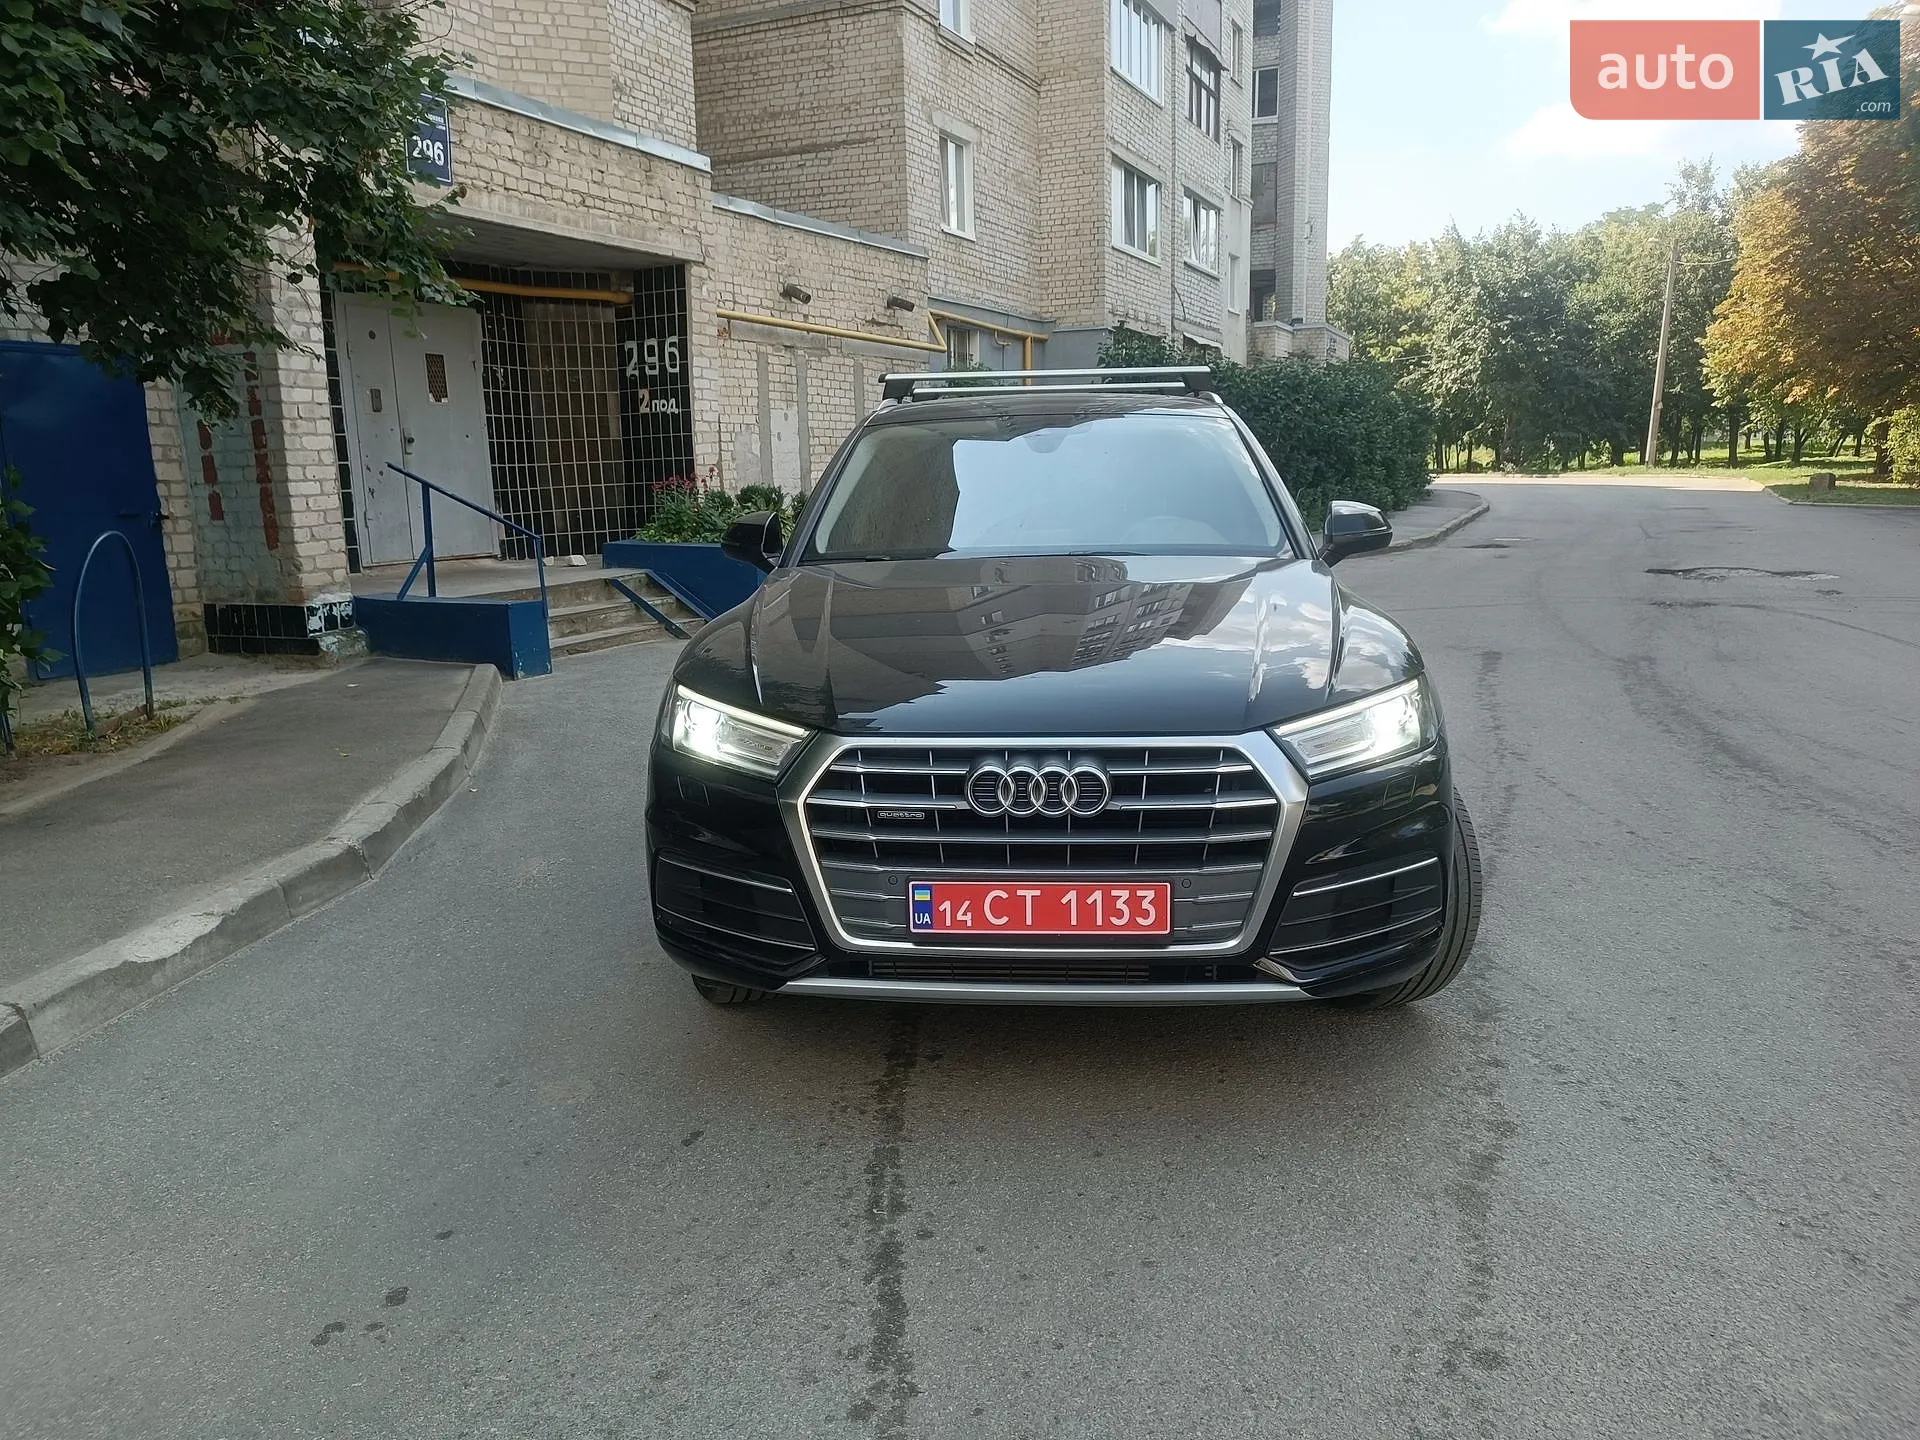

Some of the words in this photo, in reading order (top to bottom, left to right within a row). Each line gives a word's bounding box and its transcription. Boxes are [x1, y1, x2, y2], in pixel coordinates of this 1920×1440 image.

[412, 135, 445, 166] 296
[624, 336, 680, 377] 296
[879, 811, 924, 819] quattro
[914, 912, 932, 925] UA
[938, 900, 973, 927] 14
[1060, 889, 1157, 926] 1133
